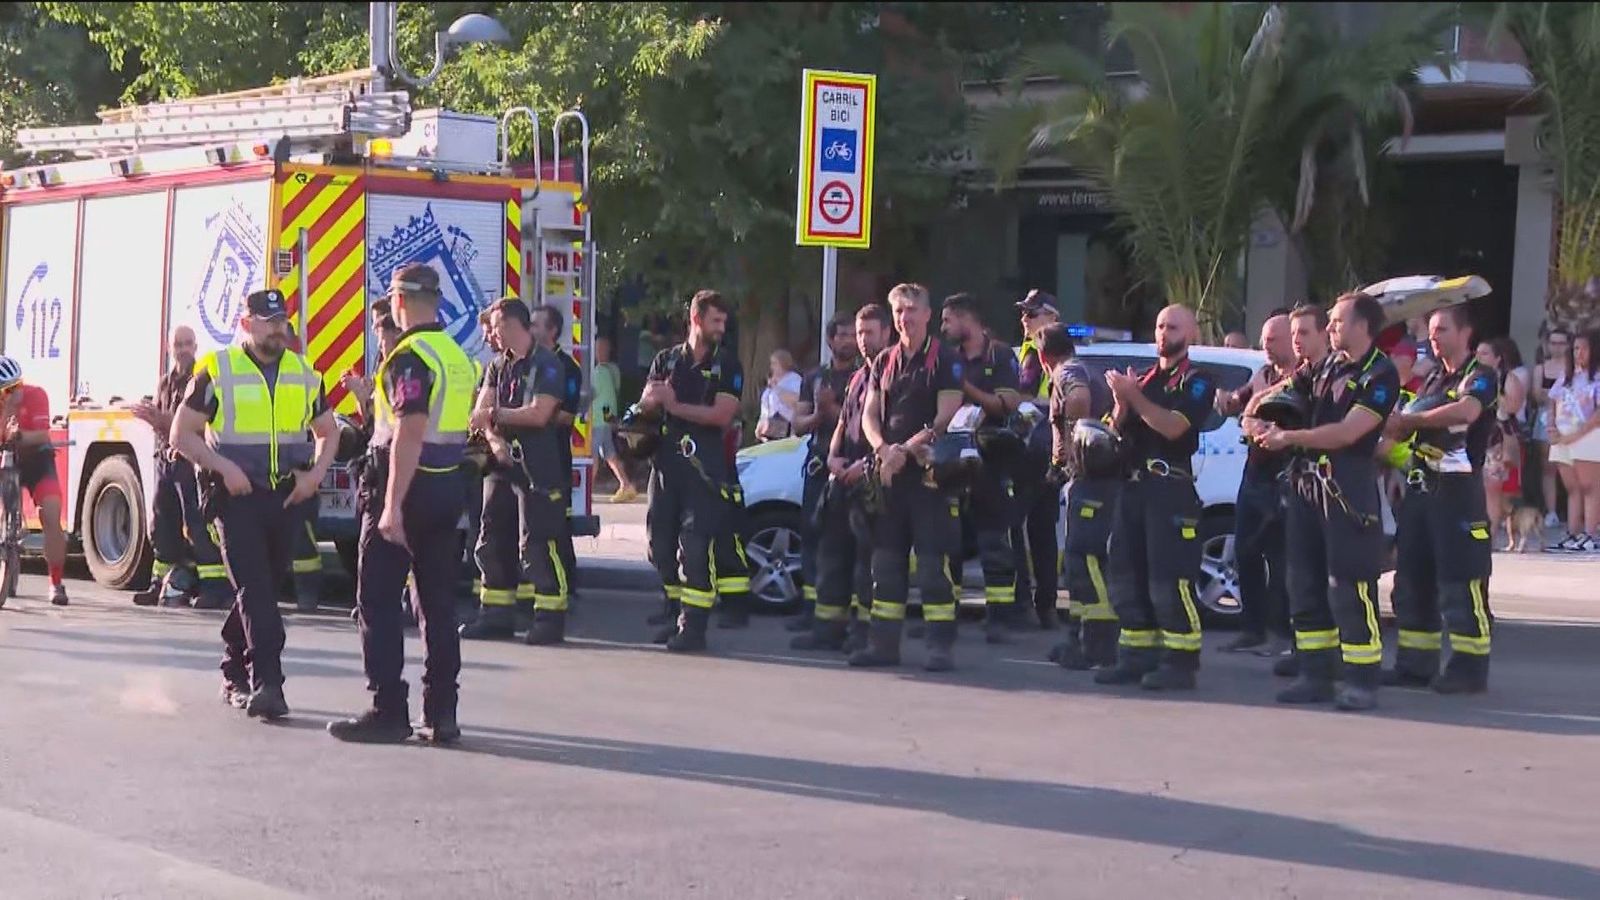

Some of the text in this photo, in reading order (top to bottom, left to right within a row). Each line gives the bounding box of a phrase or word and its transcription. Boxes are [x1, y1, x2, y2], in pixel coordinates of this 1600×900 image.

[822, 91, 858, 106] CARRIL
[830, 109, 850, 122] BICI
[31, 298, 61, 358] 112
